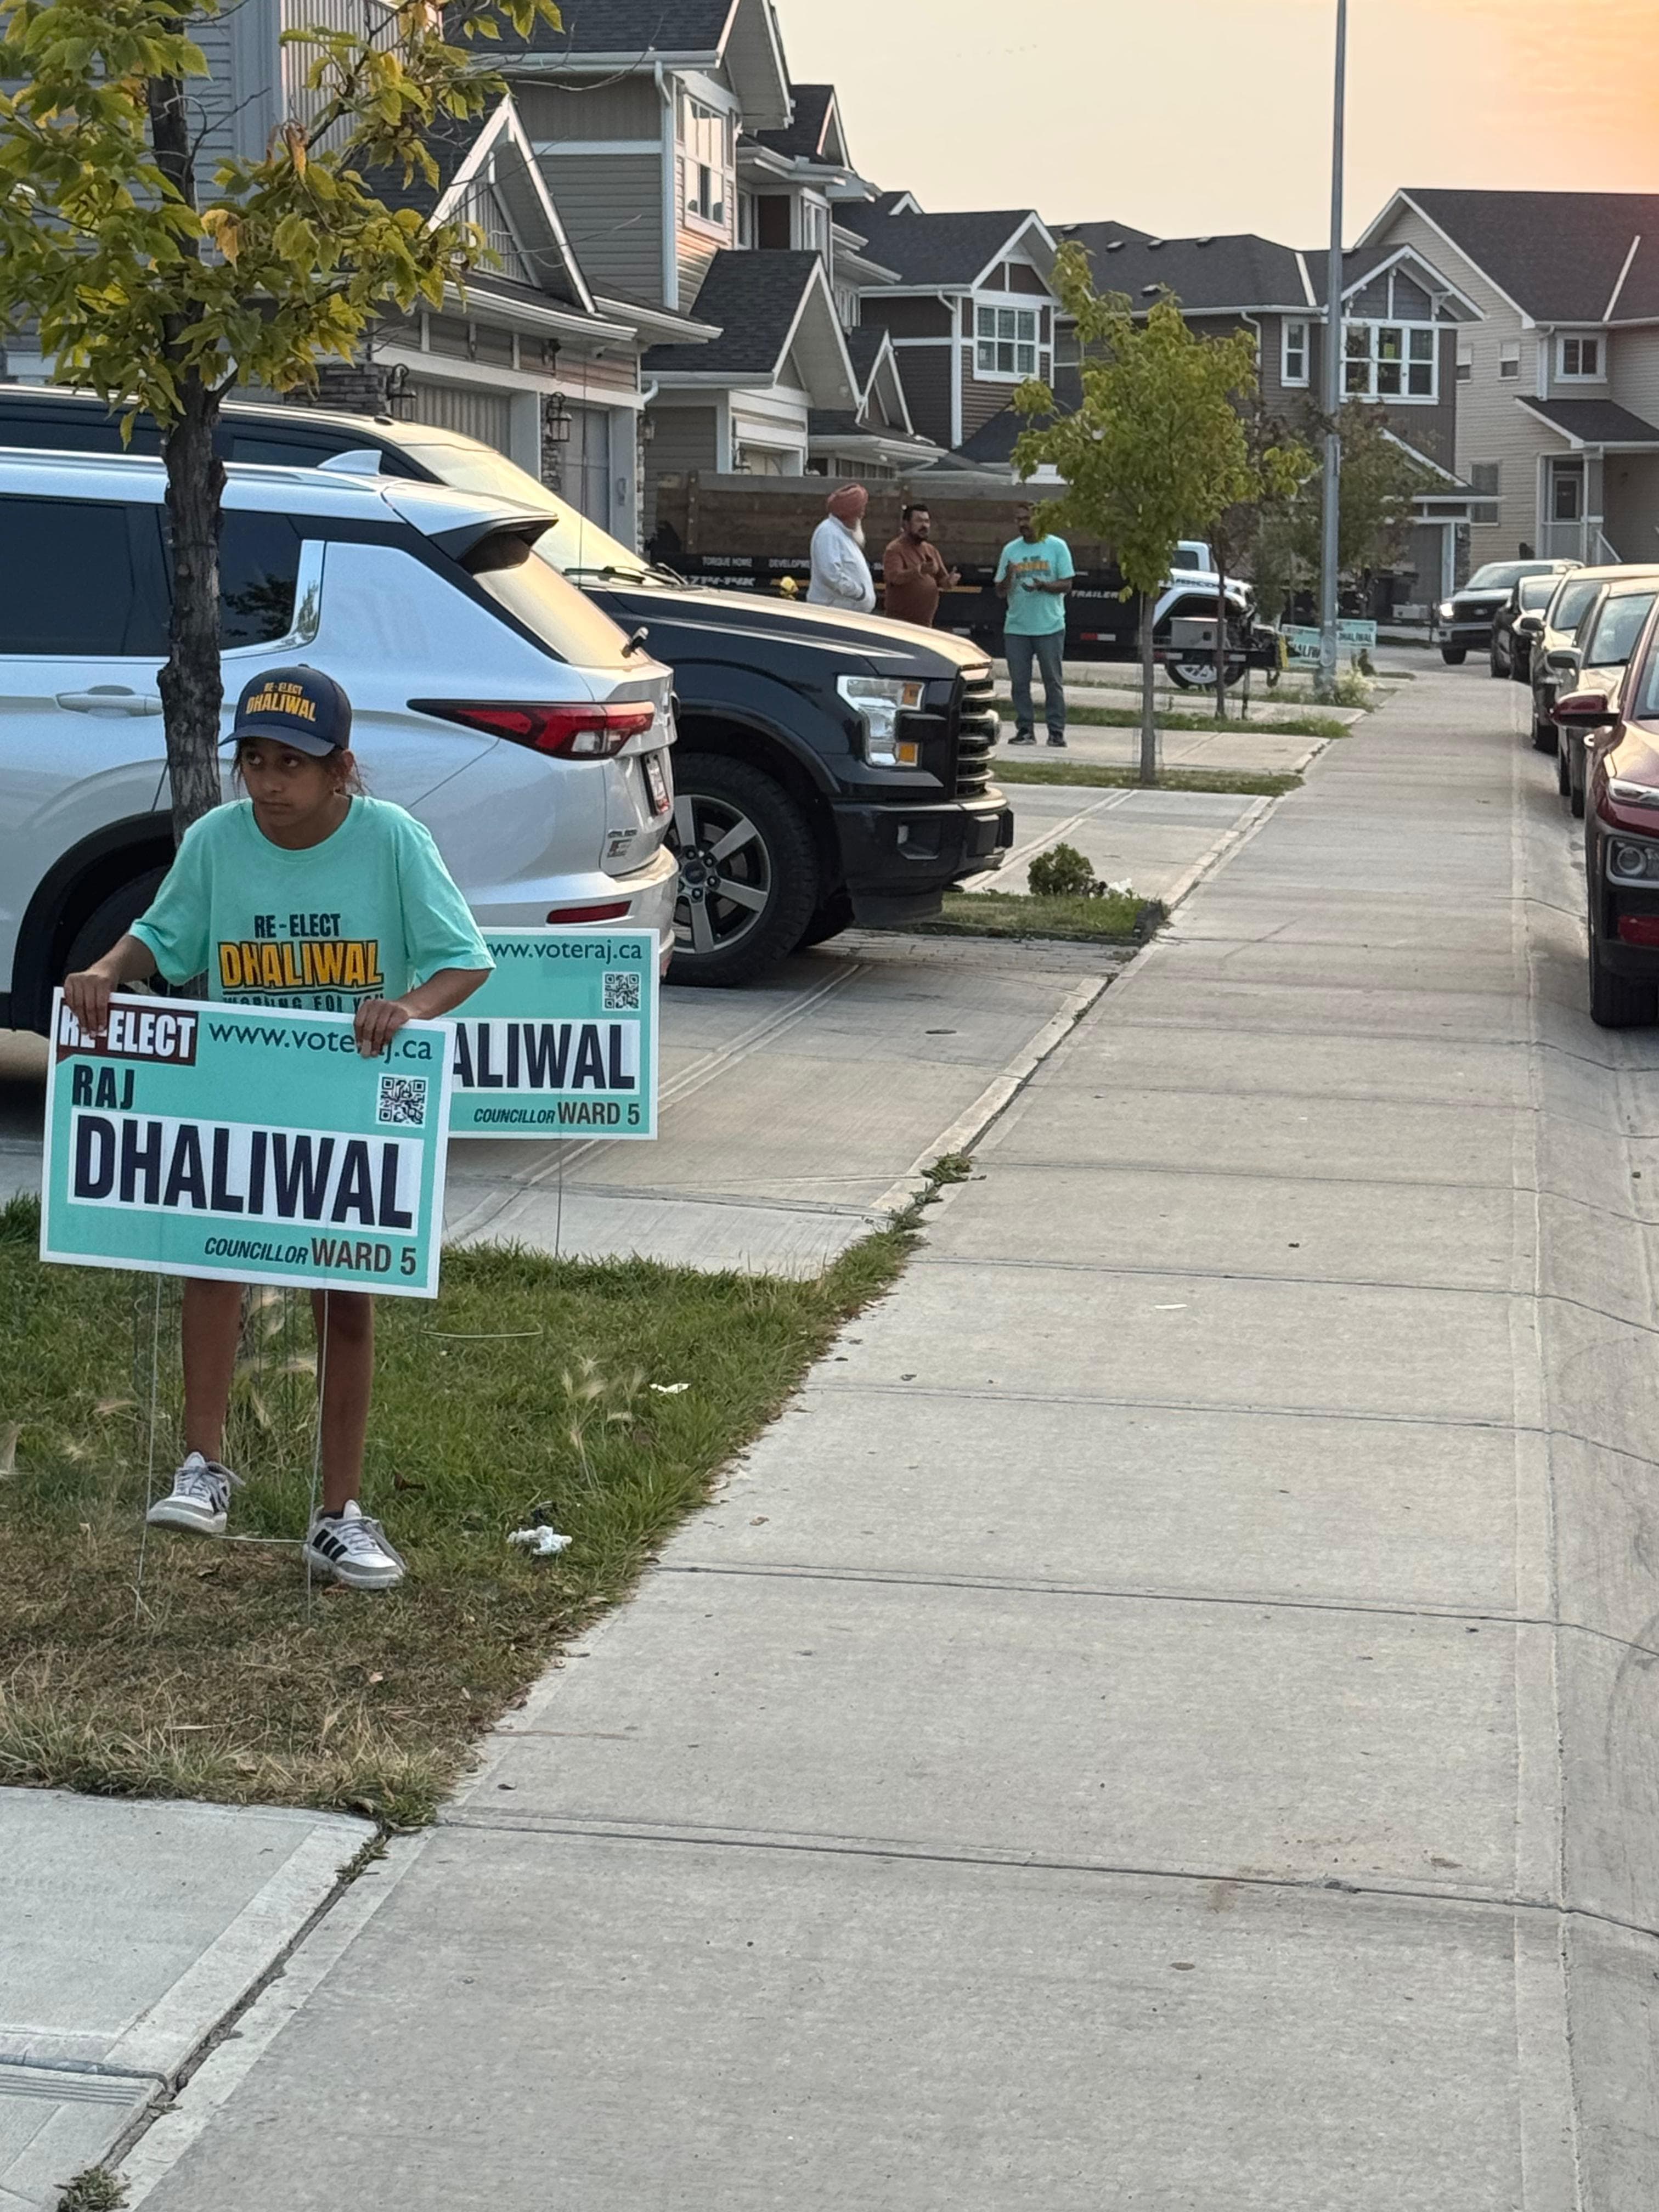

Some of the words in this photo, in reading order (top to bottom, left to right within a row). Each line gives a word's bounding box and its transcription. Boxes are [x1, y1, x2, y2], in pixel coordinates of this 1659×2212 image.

[769, 558, 811, 569] DEVELOPME
[263, 682, 303, 696] RE-ELECT
[246, 693, 317, 722] DHALIWAL
[254, 913, 341, 938] RE-ELECT
[219, 940, 383, 988] DHALIWAL
[487, 939, 642, 964] ww.voteraj.ca
[208, 1023, 433, 1064] www.votej.ca
[453, 1023, 635, 1089] ALIWAL
[72, 1064, 134, 1110] RAJ
[473, 1108, 555, 1124] COUNCILLOR
[557, 1102, 620, 1125] WARD
[627, 1103, 640, 1125] 5
[74, 1114, 413, 1229] DHALIWAL
[204, 1237, 309, 1265] COUNCILLOR
[311, 1238, 391, 1273] WARD
[400, 1247, 417, 1276] 5
